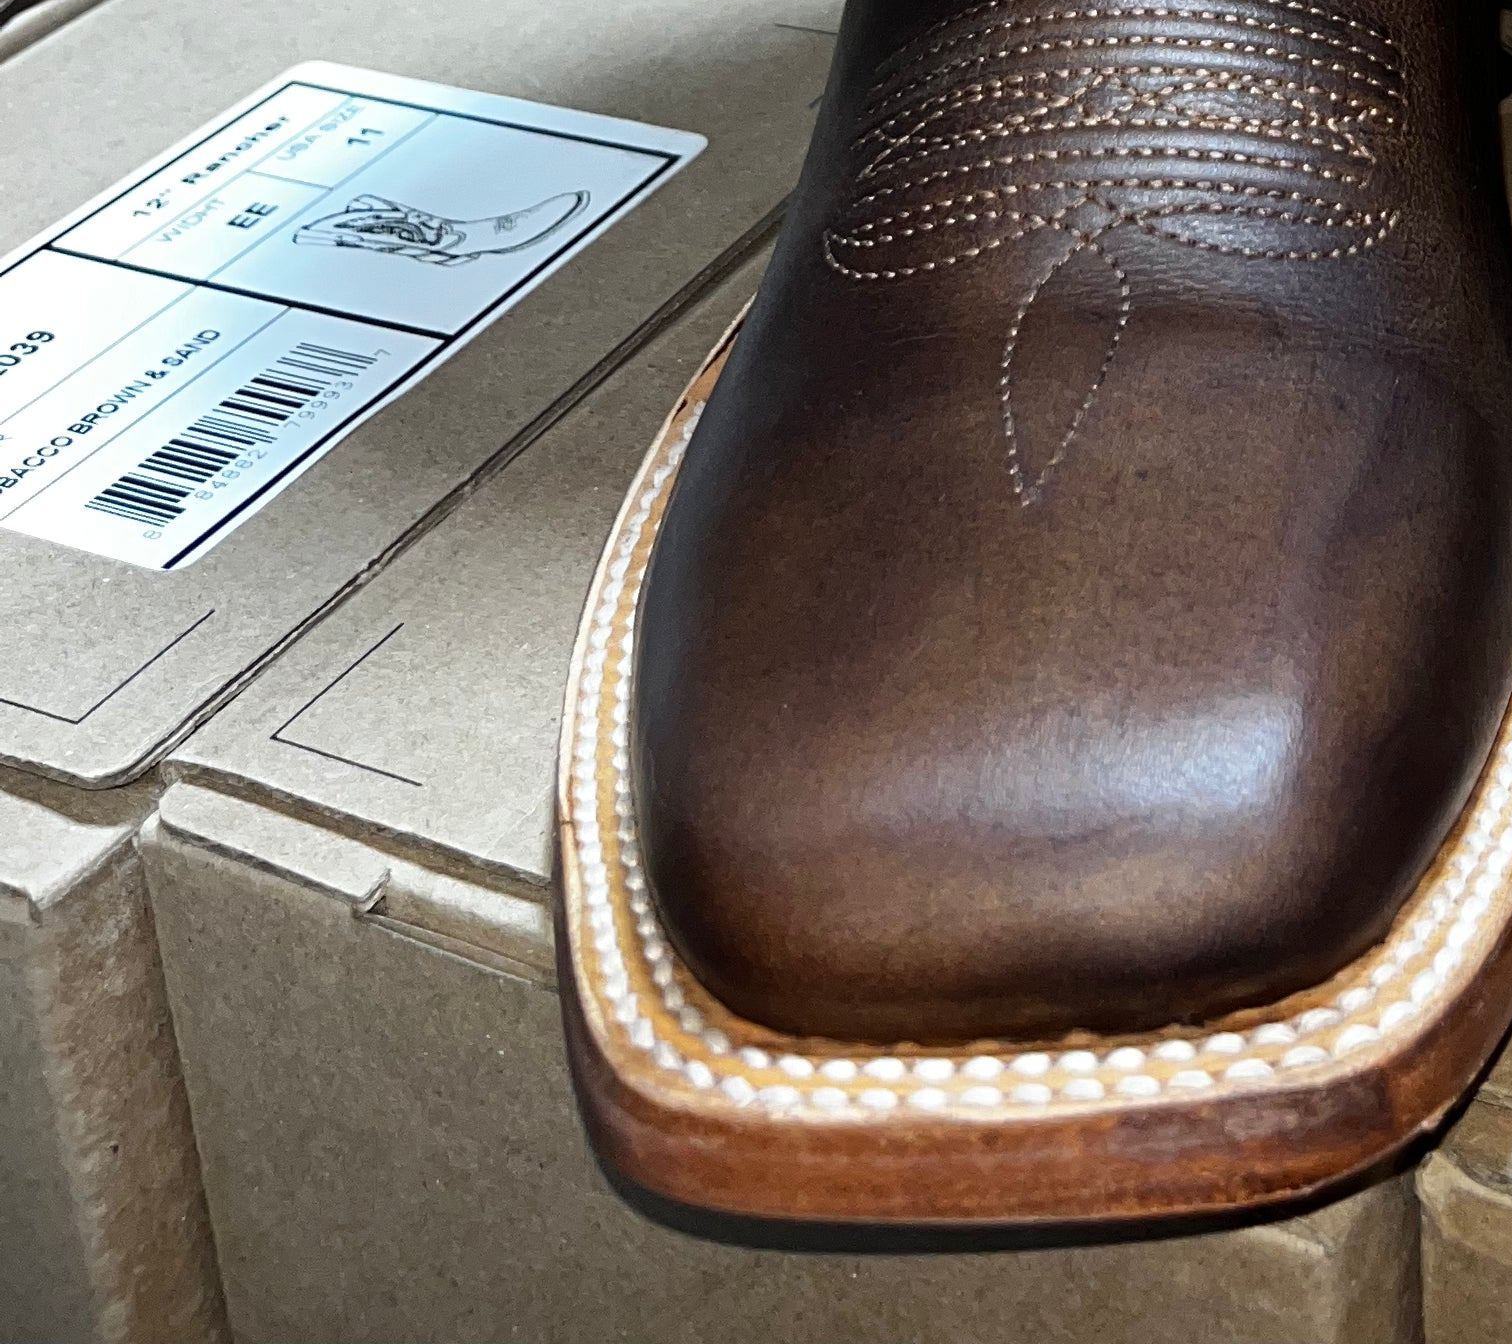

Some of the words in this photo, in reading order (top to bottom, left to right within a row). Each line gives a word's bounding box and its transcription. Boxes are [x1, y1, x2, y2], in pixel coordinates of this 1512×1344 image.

[181, 116, 290, 185] Rancher
[347, 128, 384, 146] 11
[228, 202, 279, 230] EE
[0, 330, 55, 376] 039
[0, 436, 73, 494] BACCO
[67, 380, 152, 435] BROWN
[144, 369, 170, 380] &
[161, 329, 221, 367] SAND
